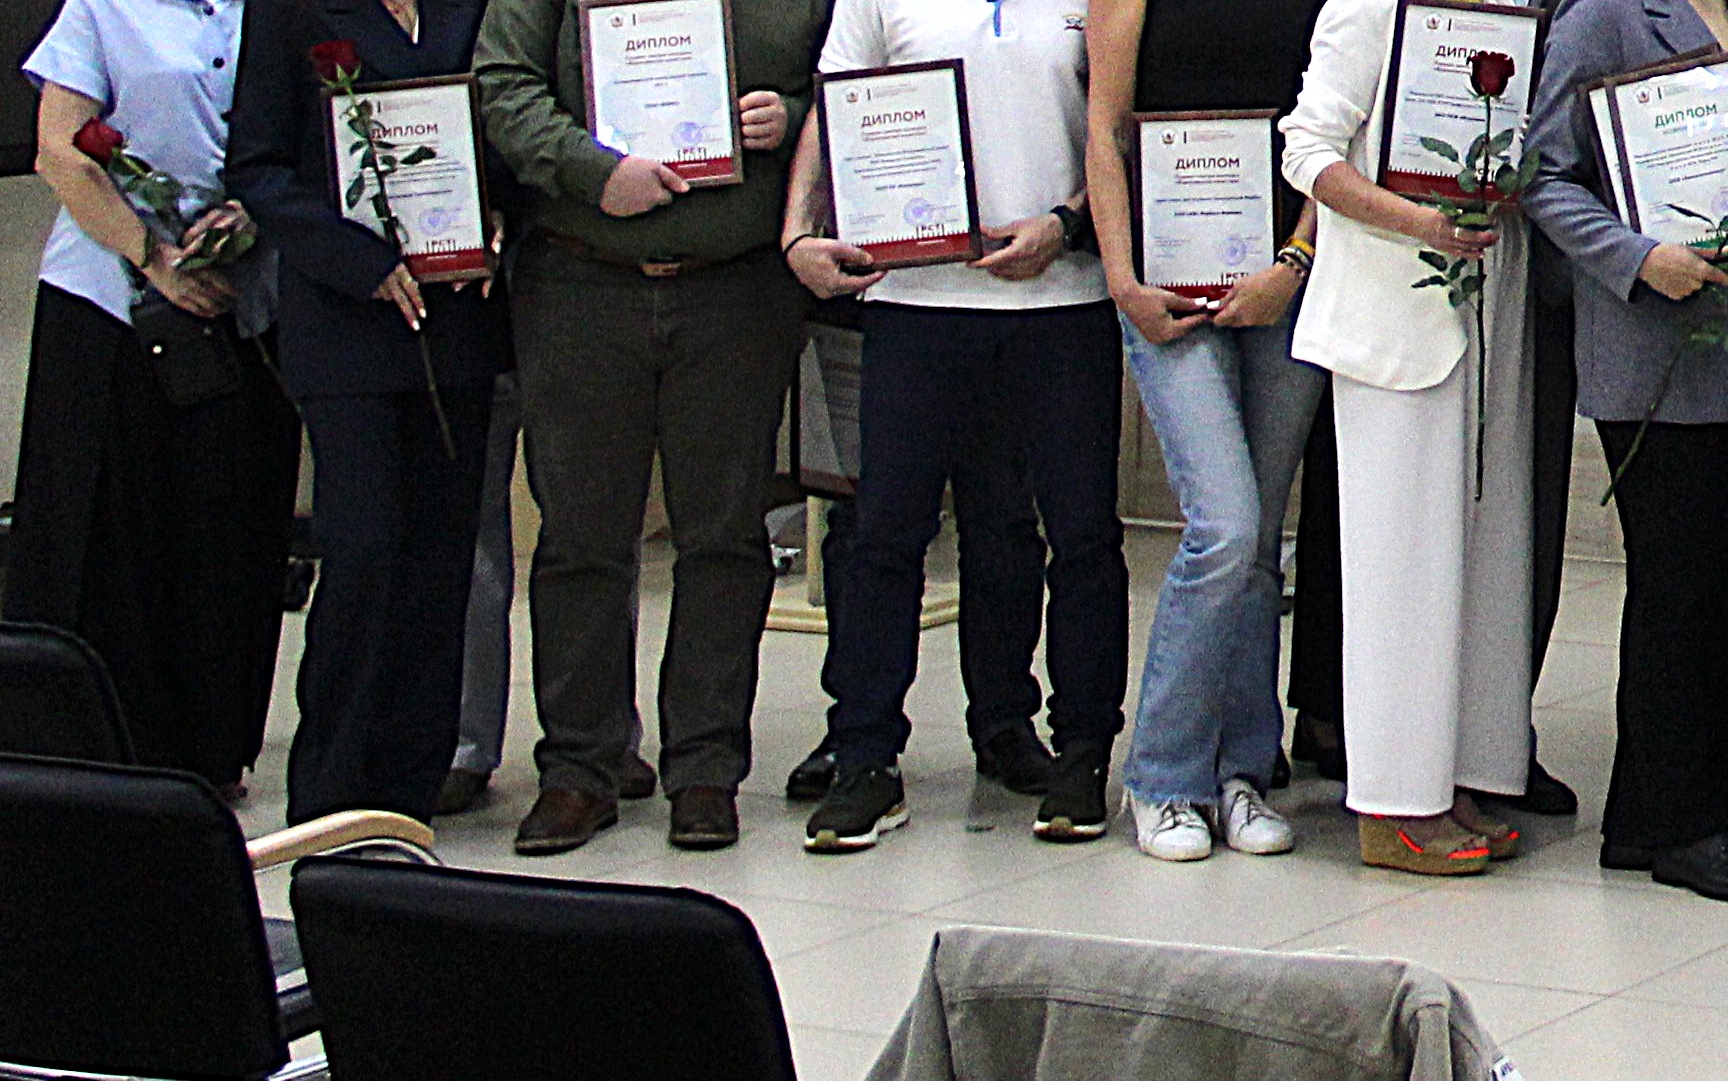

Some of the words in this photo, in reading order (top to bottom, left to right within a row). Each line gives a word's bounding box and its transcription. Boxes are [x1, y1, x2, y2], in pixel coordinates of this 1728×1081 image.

[624, 34, 692, 52] ДИПЛОМ
[1435, 45, 1477, 59] ДИПЛ
[861, 109, 926, 128] ДИПЛОМ
[1655, 103, 1718, 129] ДИПЛОМ
[1175, 157, 1240, 170] ДИПЛОМ
